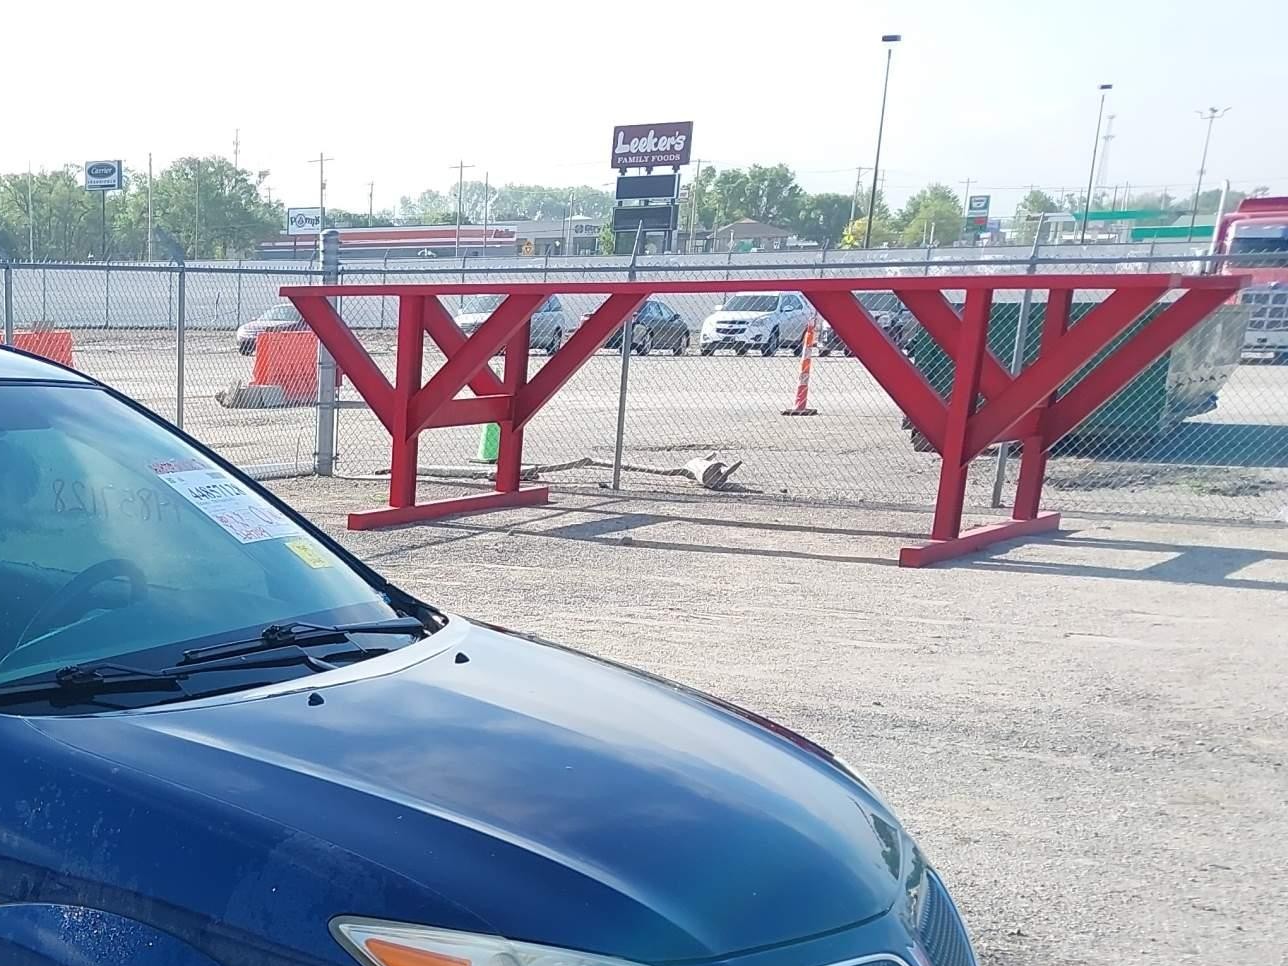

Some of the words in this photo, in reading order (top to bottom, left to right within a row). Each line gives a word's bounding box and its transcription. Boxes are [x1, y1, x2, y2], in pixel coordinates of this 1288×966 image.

[615, 129, 686, 154] Leeker's
[617, 155, 650, 164] FAMILY
[651, 154, 681, 162] FOODS
[187, 483, 248, 501] 44857128
